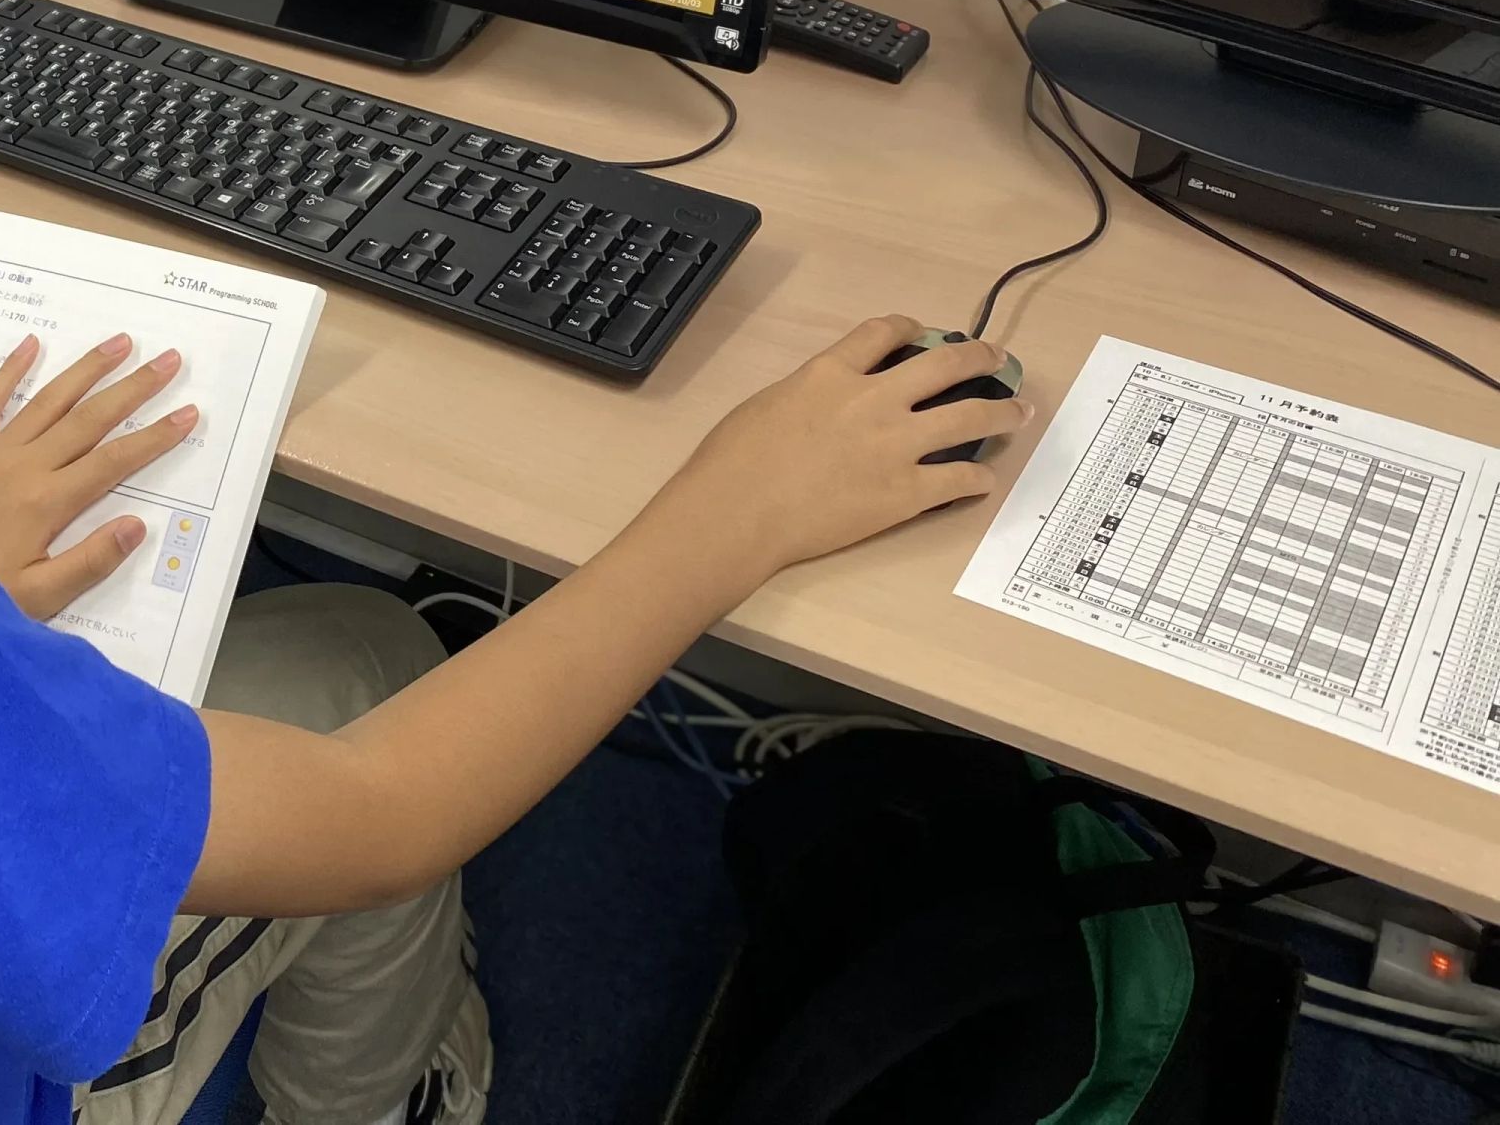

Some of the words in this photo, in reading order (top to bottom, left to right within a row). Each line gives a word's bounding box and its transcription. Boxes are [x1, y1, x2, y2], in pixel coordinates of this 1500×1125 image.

[722, 6, 740, 15] 1080p
[621, 251, 640, 261] PgUp
[508, 269, 522, 278] End
[178, 275, 208, 293] STAR
[208, 287, 252, 305] Programming
[252, 297, 279, 310] SCHOOL
[586, 294, 604, 305] PgDn
[633, 299, 651, 310] Enter
[568, 318, 580, 327] Del
[1260, 394, 1274, 403] 11
[1279, 398, 1340, 424] 月予約表
[1084, 594, 1105, 606] 10:00
[1110, 604, 1132, 615] 11:00
[1206, 638, 1229, 651] 14:30
